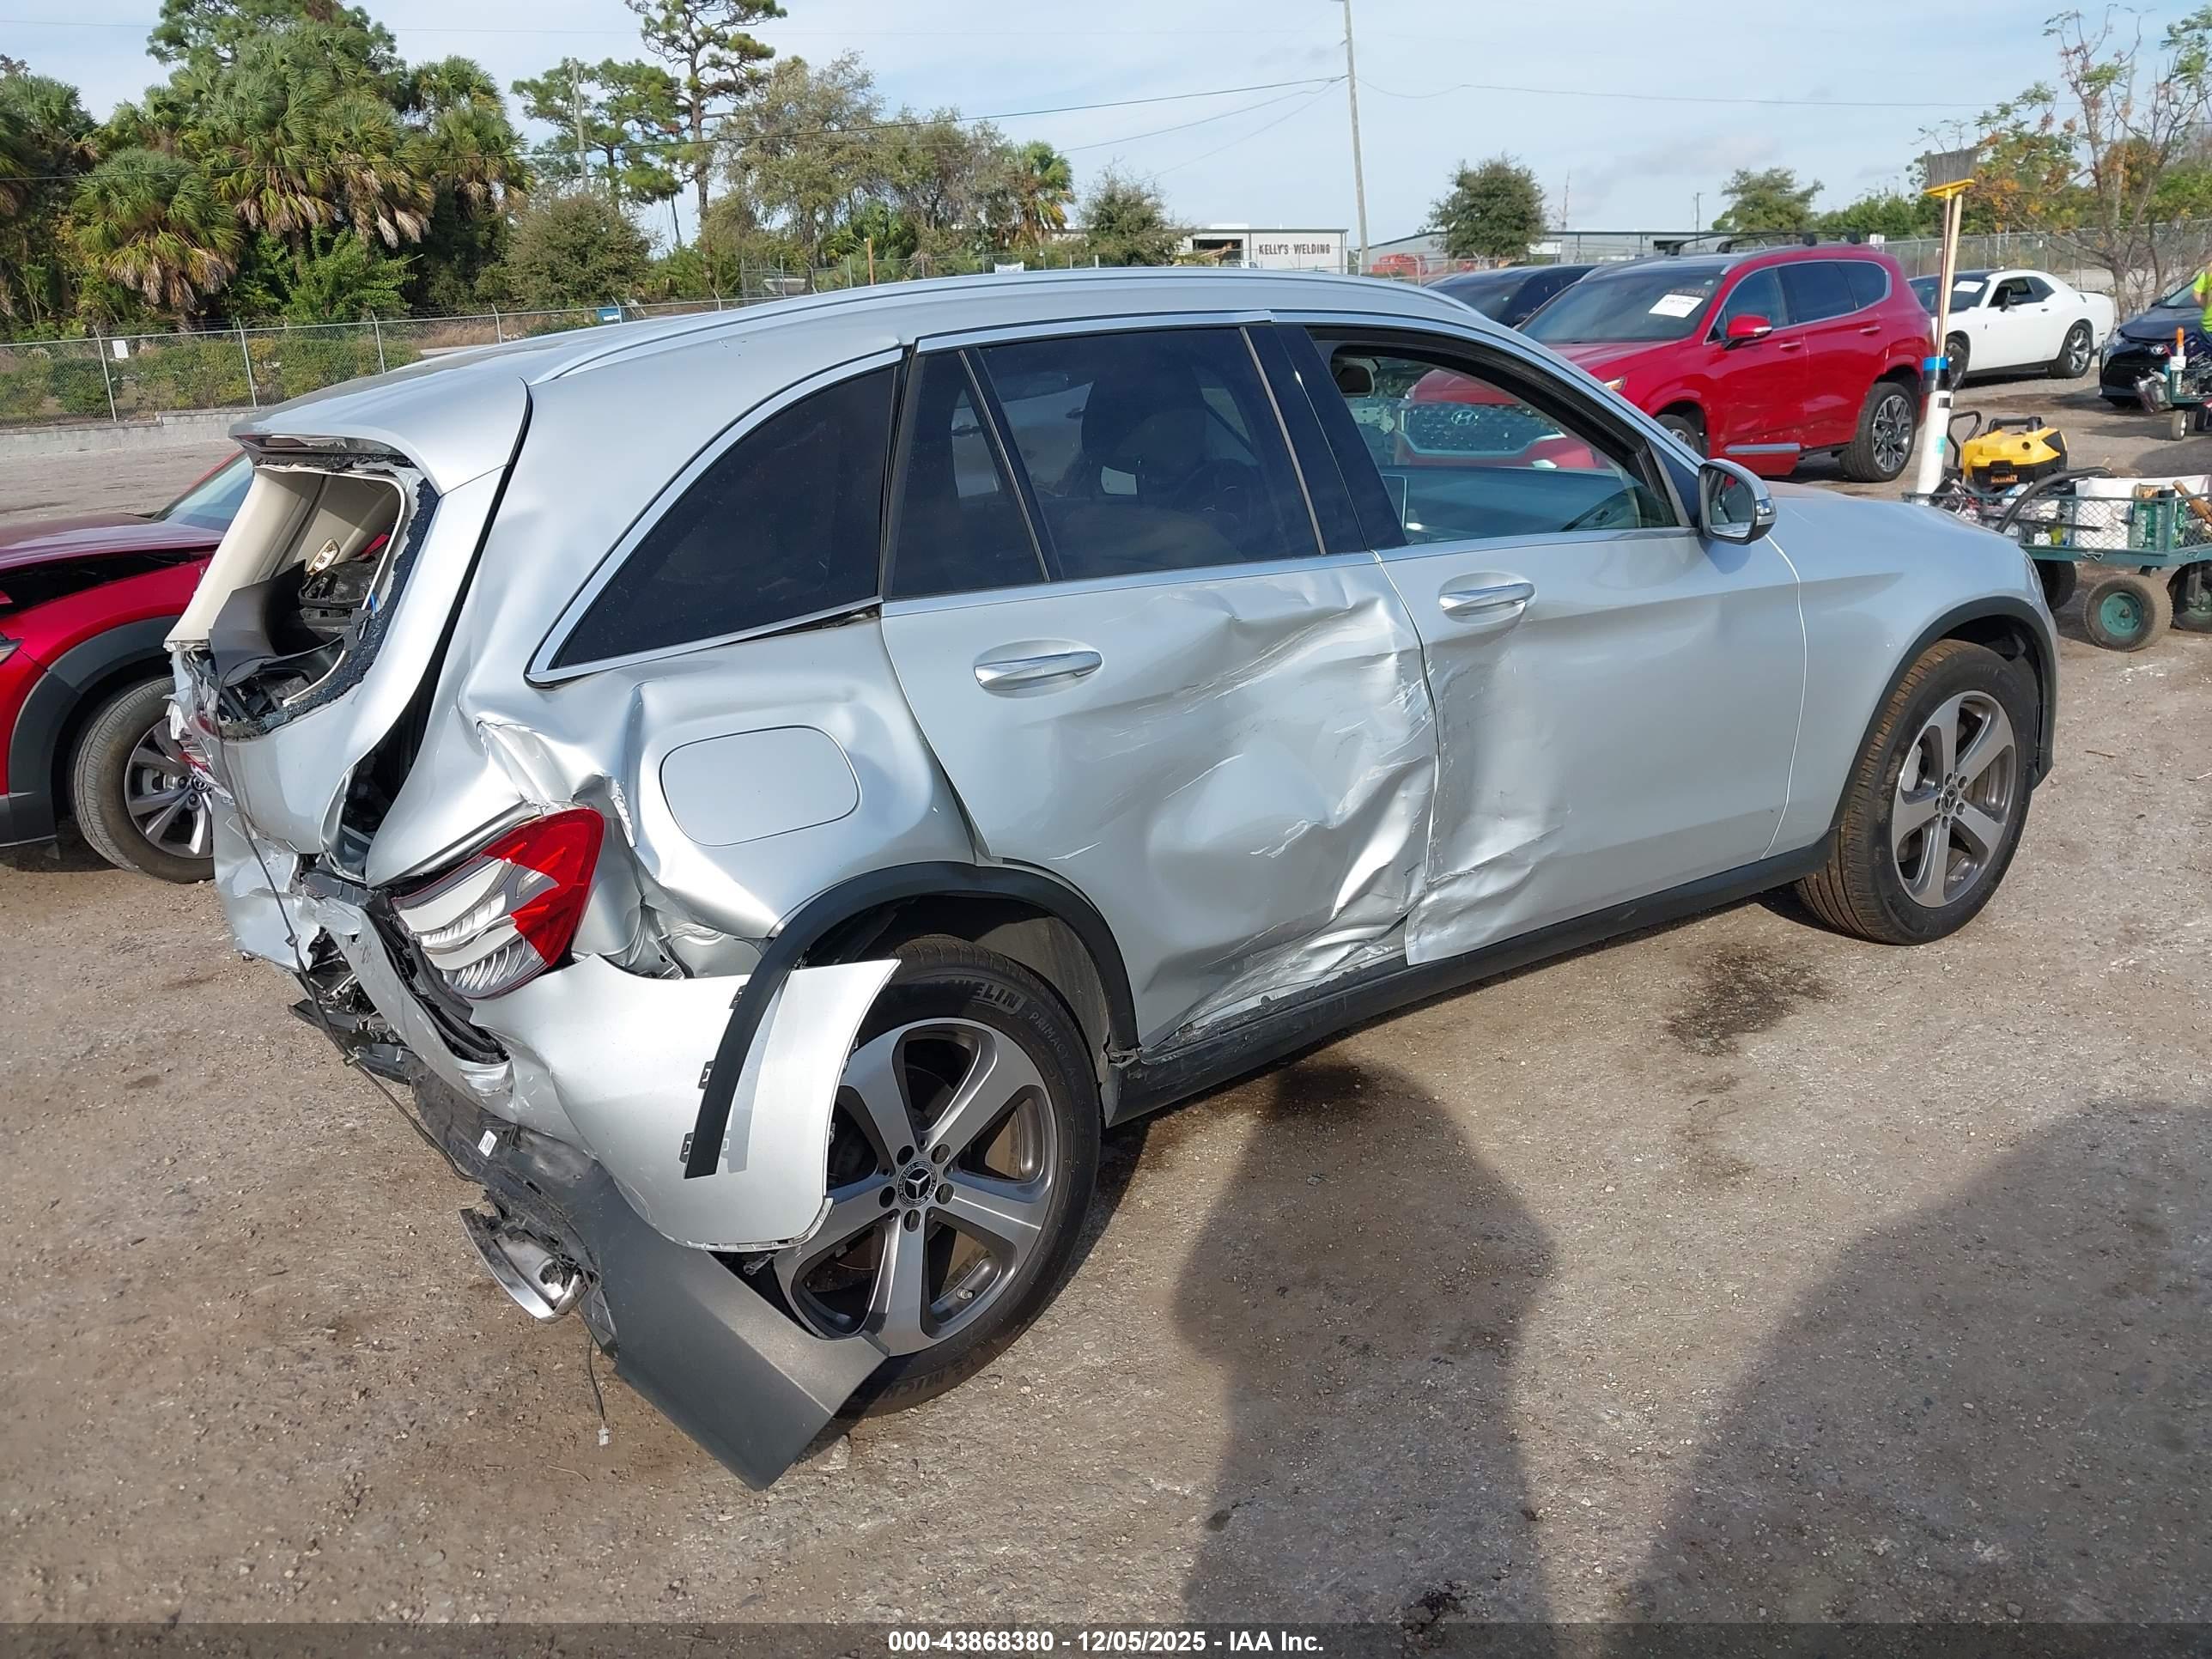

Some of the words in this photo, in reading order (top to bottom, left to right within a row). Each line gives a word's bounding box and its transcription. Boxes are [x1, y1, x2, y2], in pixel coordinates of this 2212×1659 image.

[1259, 244, 1289, 255] KELLY'S
[1293, 244, 1331, 254] WELDING
[1029, 1011, 1071, 1060] PRIMACY
